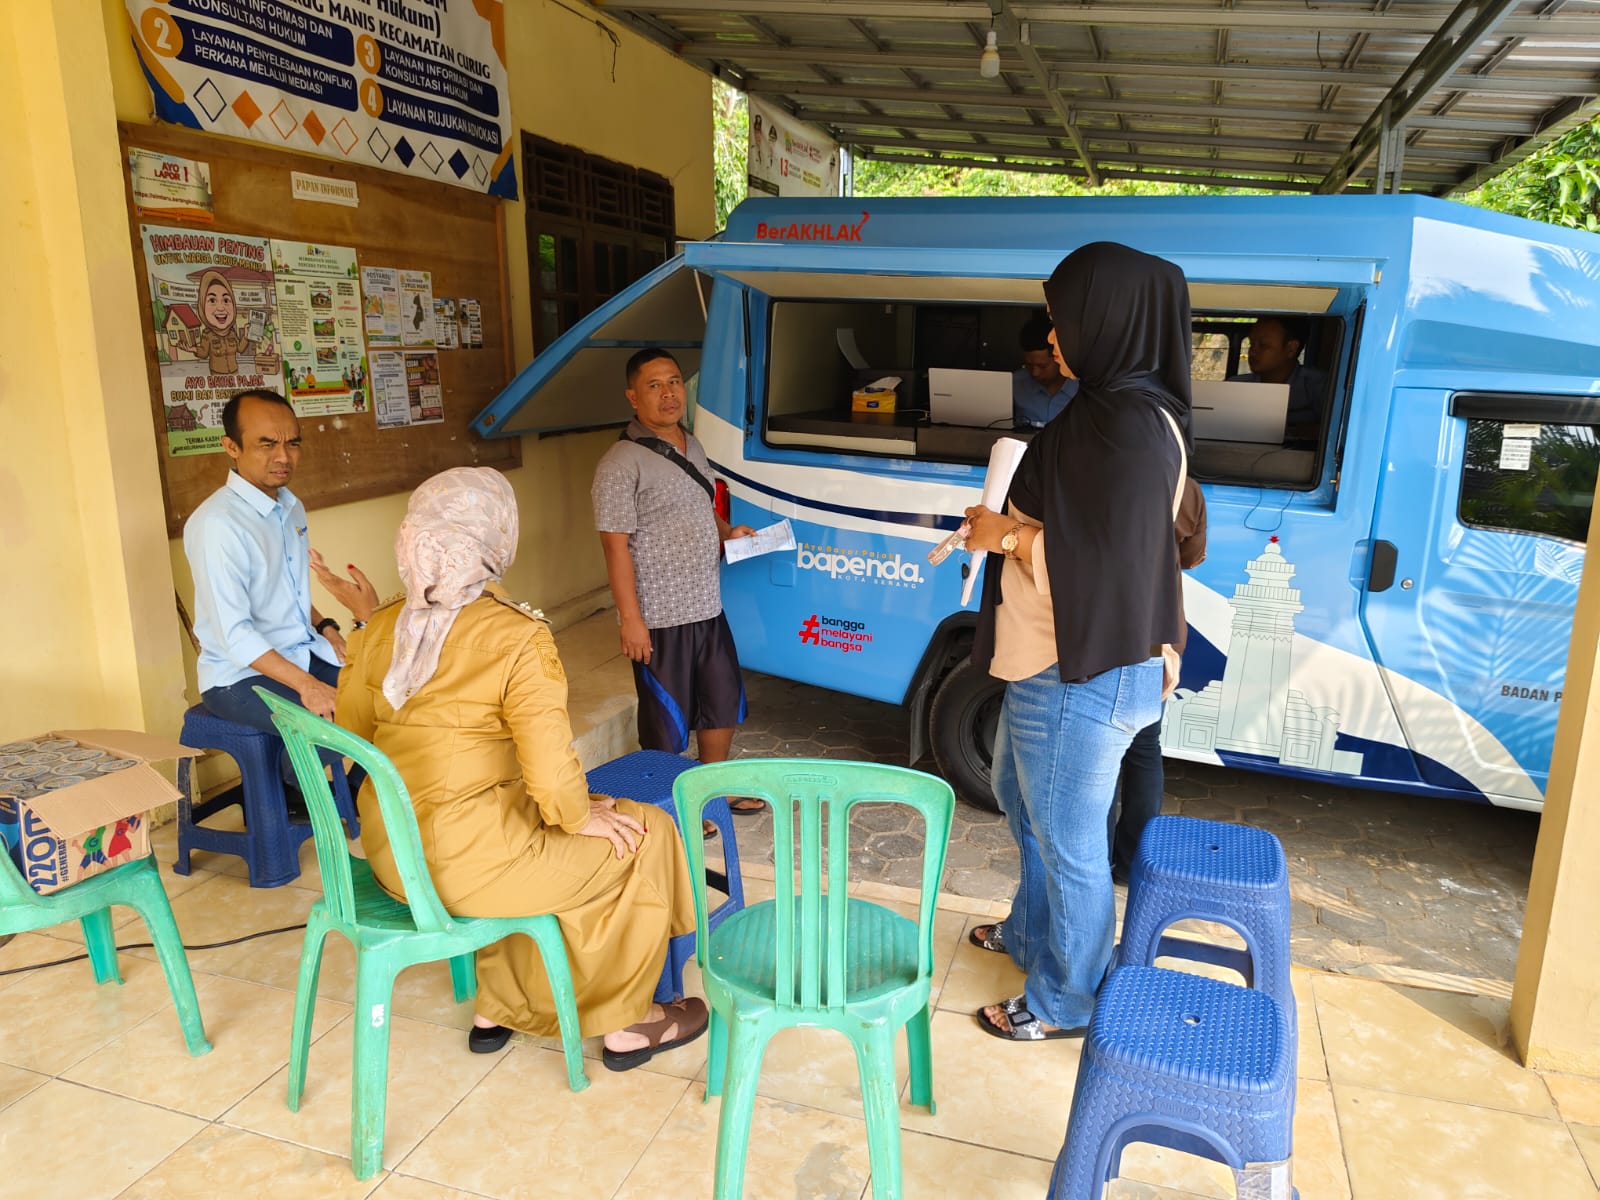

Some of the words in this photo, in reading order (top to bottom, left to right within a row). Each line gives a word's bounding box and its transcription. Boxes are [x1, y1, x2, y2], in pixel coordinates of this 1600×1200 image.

[249, 0, 307, 30] INFORMASI
[310, 20, 333, 39] DAN
[154, 18, 172, 50] 2
[269, 21, 306, 46] HUKUM
[329, 0, 375, 33] MANIS
[379, 19, 456, 63] KECAMATAN
[457, 52, 490, 79] CURUG
[192, 28, 244, 54] LAYANAN
[246, 46, 311, 78] PENYELESAIAN
[363, 40, 375, 68] 3
[194, 45, 248, 71] PERKARA
[249, 61, 288, 85] MELALUI
[288, 76, 323, 95] MEDIASI
[384, 48, 425, 73] LAYANAN
[426, 62, 469, 87] INFORMASI
[469, 82, 483, 95] DAN
[385, 63, 441, 91] KONSULTASI
[443, 83, 468, 102] HUKUM
[367, 86, 377, 111] 4
[386, 97, 427, 122] LAYANAN
[427, 106, 468, 132] RUJUKAN
[467, 124, 499, 145] ADVOKASI
[154, 169, 181, 182] LAPOR
[162, 161, 180, 172] AYO
[296, 178, 319, 193] PAPAN
[320, 183, 354, 199] INFORMASI
[756, 210, 870, 242] BerAKHLAK
[149, 233, 215, 252] HIMBAUAN
[218, 237, 265, 261] PENTING
[154, 252, 184, 266] UNTUK
[184, 252, 212, 264] WARGA
[213, 254, 238, 267] CURUG
[185, 376, 205, 389] AYO
[207, 375, 236, 388] BAYAR
[237, 374, 265, 386] PAJAK
[170, 390, 194, 402] BUMI
[195, 389, 213, 400] DAN
[797, 542, 924, 583] bapenda.
[838, 575, 866, 583] KOTA
[874, 579, 917, 589] SERANG
[821, 615, 865, 632] bangga
[821, 628, 873, 642] melayani
[821, 637, 862, 653] bangsa
[1501, 685, 1549, 701] BADAN
[57, 837, 69, 882] #GENERAS
